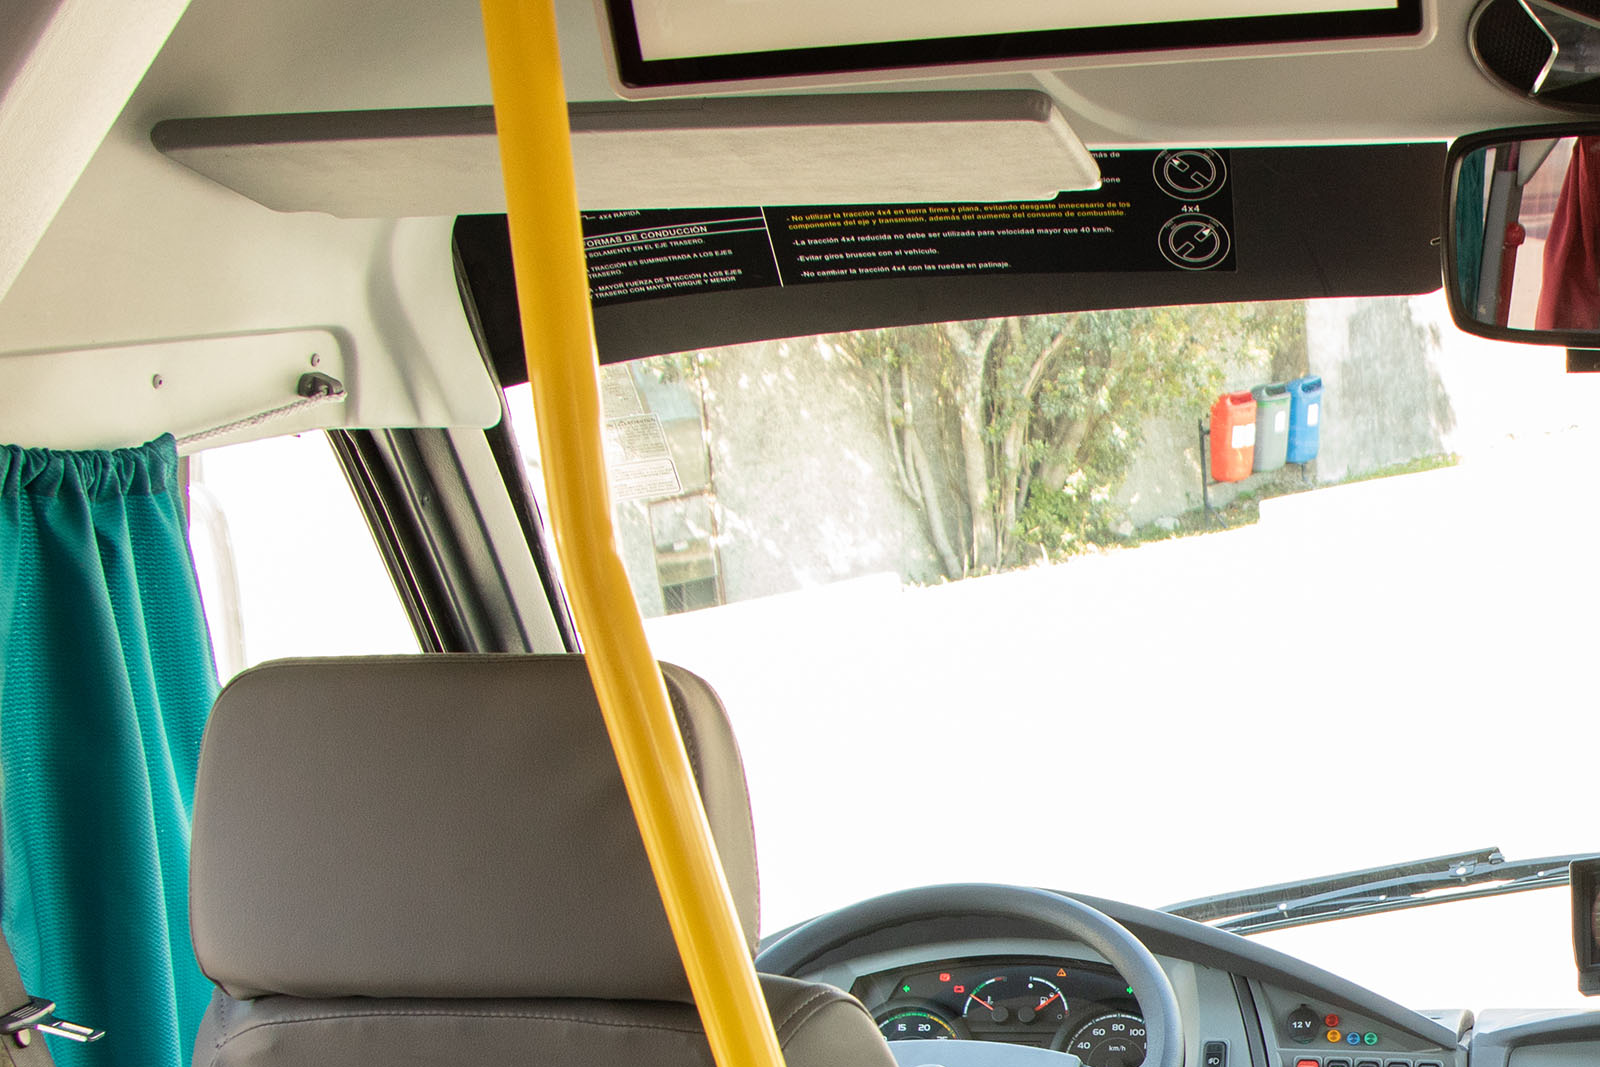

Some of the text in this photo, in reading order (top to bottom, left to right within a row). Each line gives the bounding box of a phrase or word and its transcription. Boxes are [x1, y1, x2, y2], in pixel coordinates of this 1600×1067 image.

[805, 213, 832, 221] utilizar
[843, 210, 875, 218] tracción
[906, 207, 927, 215] tierra
[983, 203, 1018, 211] evitando
[1020, 203, 1056, 211] desgaste
[1181, 204, 1200, 213] 4x4
[788, 220, 842, 231] componentes
[857, 218, 870, 227] eje
[976, 211, 1010, 219] aumento
[583, 225, 708, 247] ORMAS DE CONDUCCIÓN
[807, 237, 839, 245] tracción
[857, 233, 892, 241] reducida
[906, 231, 926, 239] debe
[942, 229, 975, 238] utilizada
[977, 229, 995, 237] para
[996, 228, 1035, 236] velocidad
[1036, 227, 1061, 235] mayor
[1063, 227, 1078, 235] que
[589, 247, 632, 258] SOLAMENTE
[628, 259, 638, 267] ES
[639, 253, 691, 266] SUMINISTRADA
[699, 250, 714, 258] LOS
[714, 249, 733, 257] EJES
[824, 253, 844, 262] giros
[845, 251, 876, 259] bruscos
[816, 268, 848, 277] cambiar
[858, 265, 890, 274] tracción
[924, 263, 937, 271] las
[937, 262, 965, 270] ruedas
[598, 282, 624, 292] MAYOR
[625, 279, 653, 288] FUERZA
[709, 270, 724, 278] LOS
[724, 268, 743, 276] EJES
[595, 289, 628, 299] TRASERO
[646, 282, 672, 291] MAYOR
[673, 279, 703, 288] TORQUE
[709, 276, 736, 284] MENOR
[897, 1023, 907, 1032] 15
[917, 1023, 931, 1032] 20
[1111, 1023, 1126, 1031] 80
[1292, 1021, 1312, 1029] 12 V
[1092, 1028, 1106, 1036] 60
[1129, 1028, 1146, 1037] 100
[1077, 1041, 1091, 1050] 40
[1108, 1044, 1126, 1052] km/h
